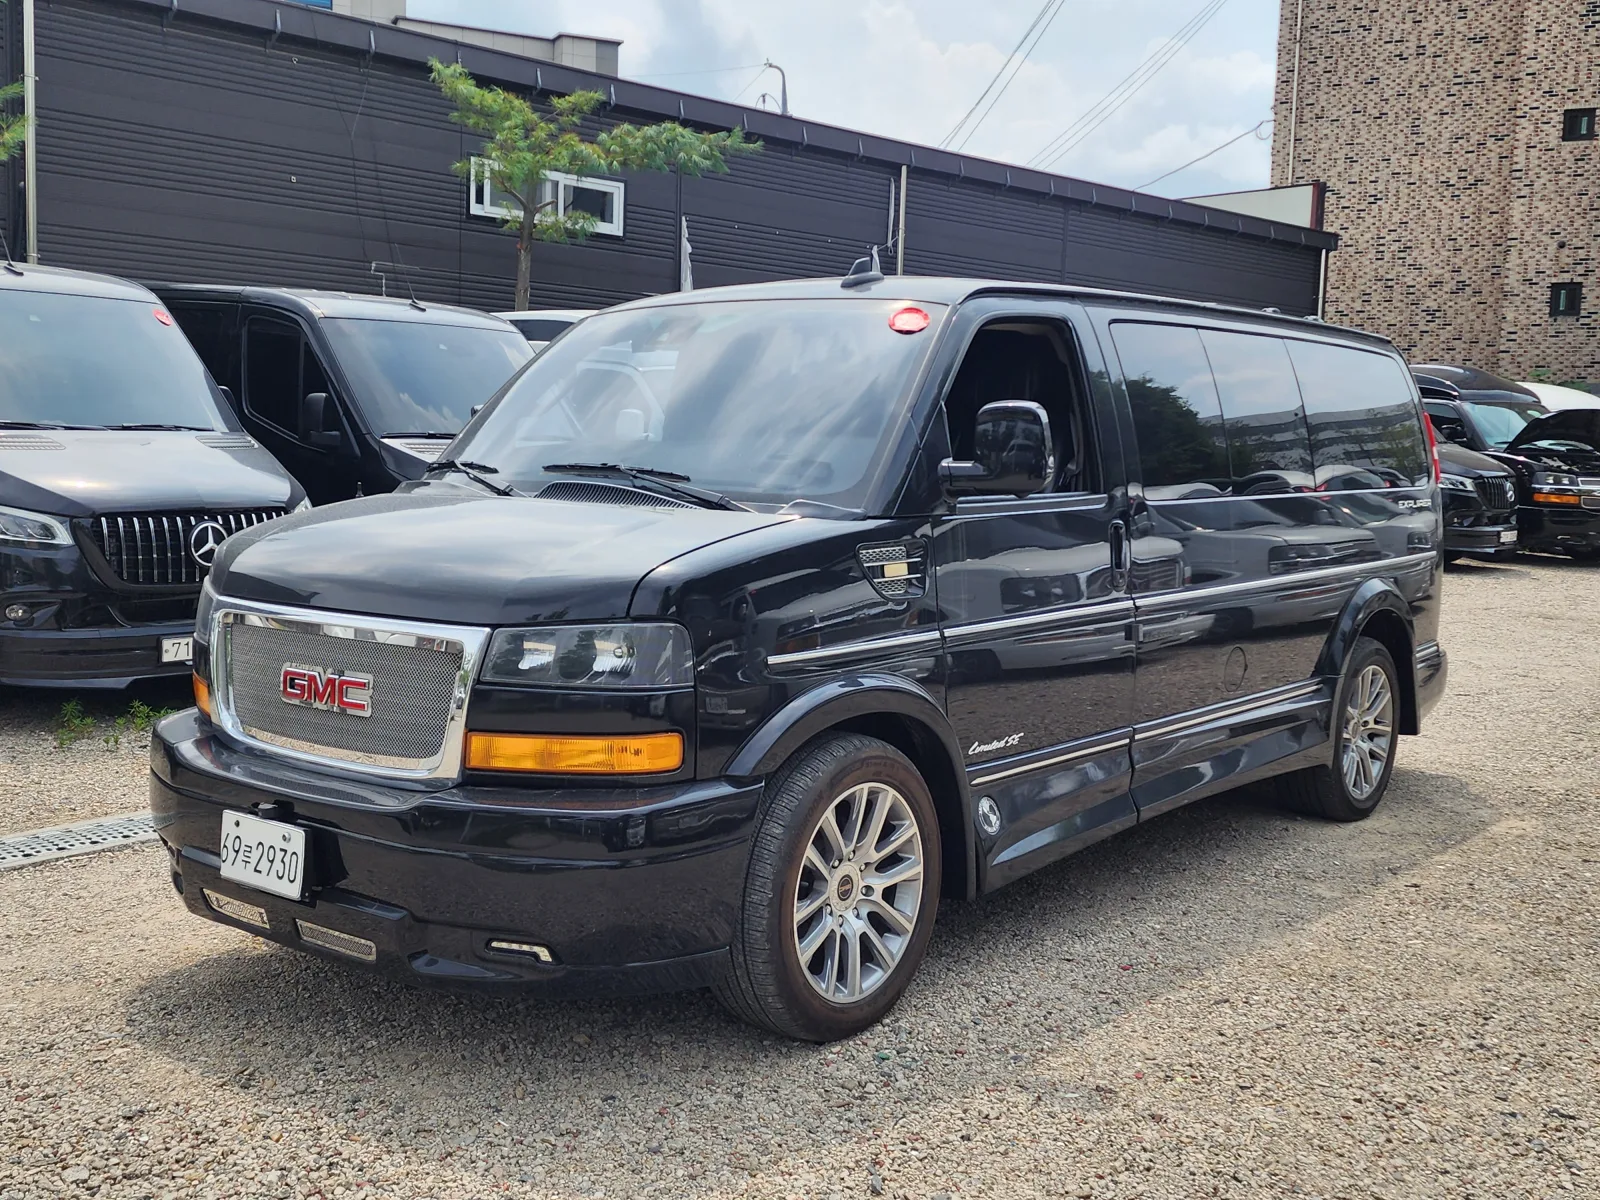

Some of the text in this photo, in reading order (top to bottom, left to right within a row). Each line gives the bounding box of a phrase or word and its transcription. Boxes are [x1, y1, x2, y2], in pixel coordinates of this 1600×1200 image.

[171, 641, 190, 658] 71
[282, 667, 370, 712] GMC
[1006, 732, 1025, 747] SE
